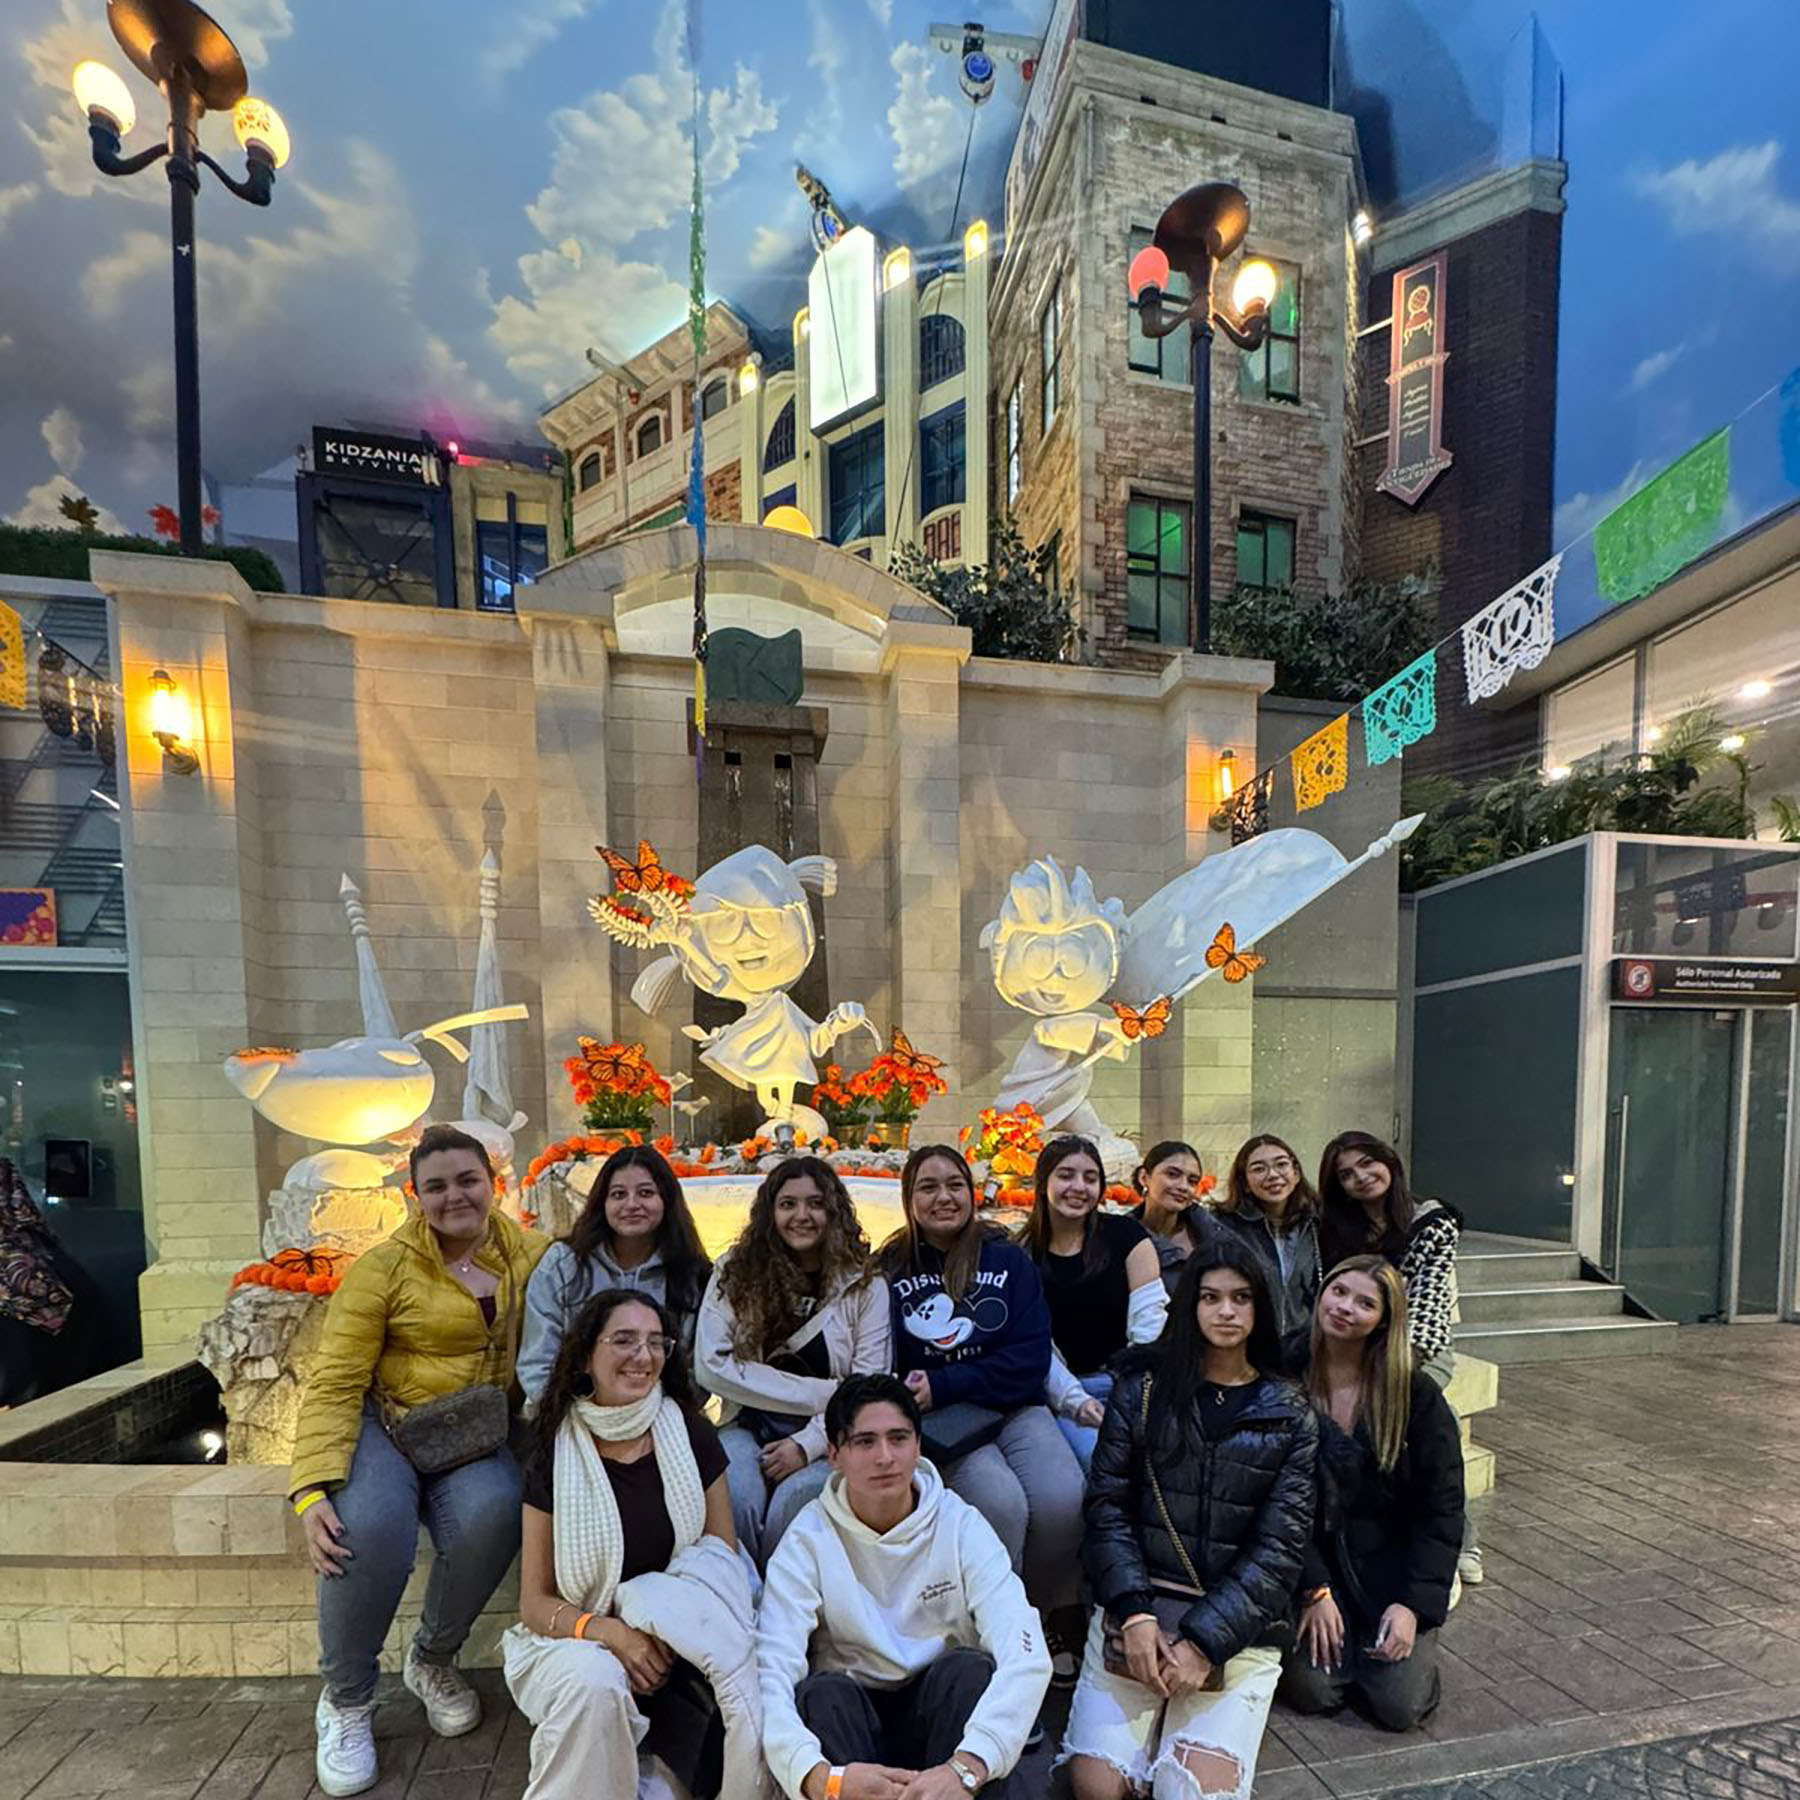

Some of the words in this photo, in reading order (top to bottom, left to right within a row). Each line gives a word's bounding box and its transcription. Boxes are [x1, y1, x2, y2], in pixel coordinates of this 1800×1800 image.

[325, 441, 421, 463] KIDZANIA
[1696, 967, 1734, 978] Personal
[1736, 968, 1781, 980] Autorizado
